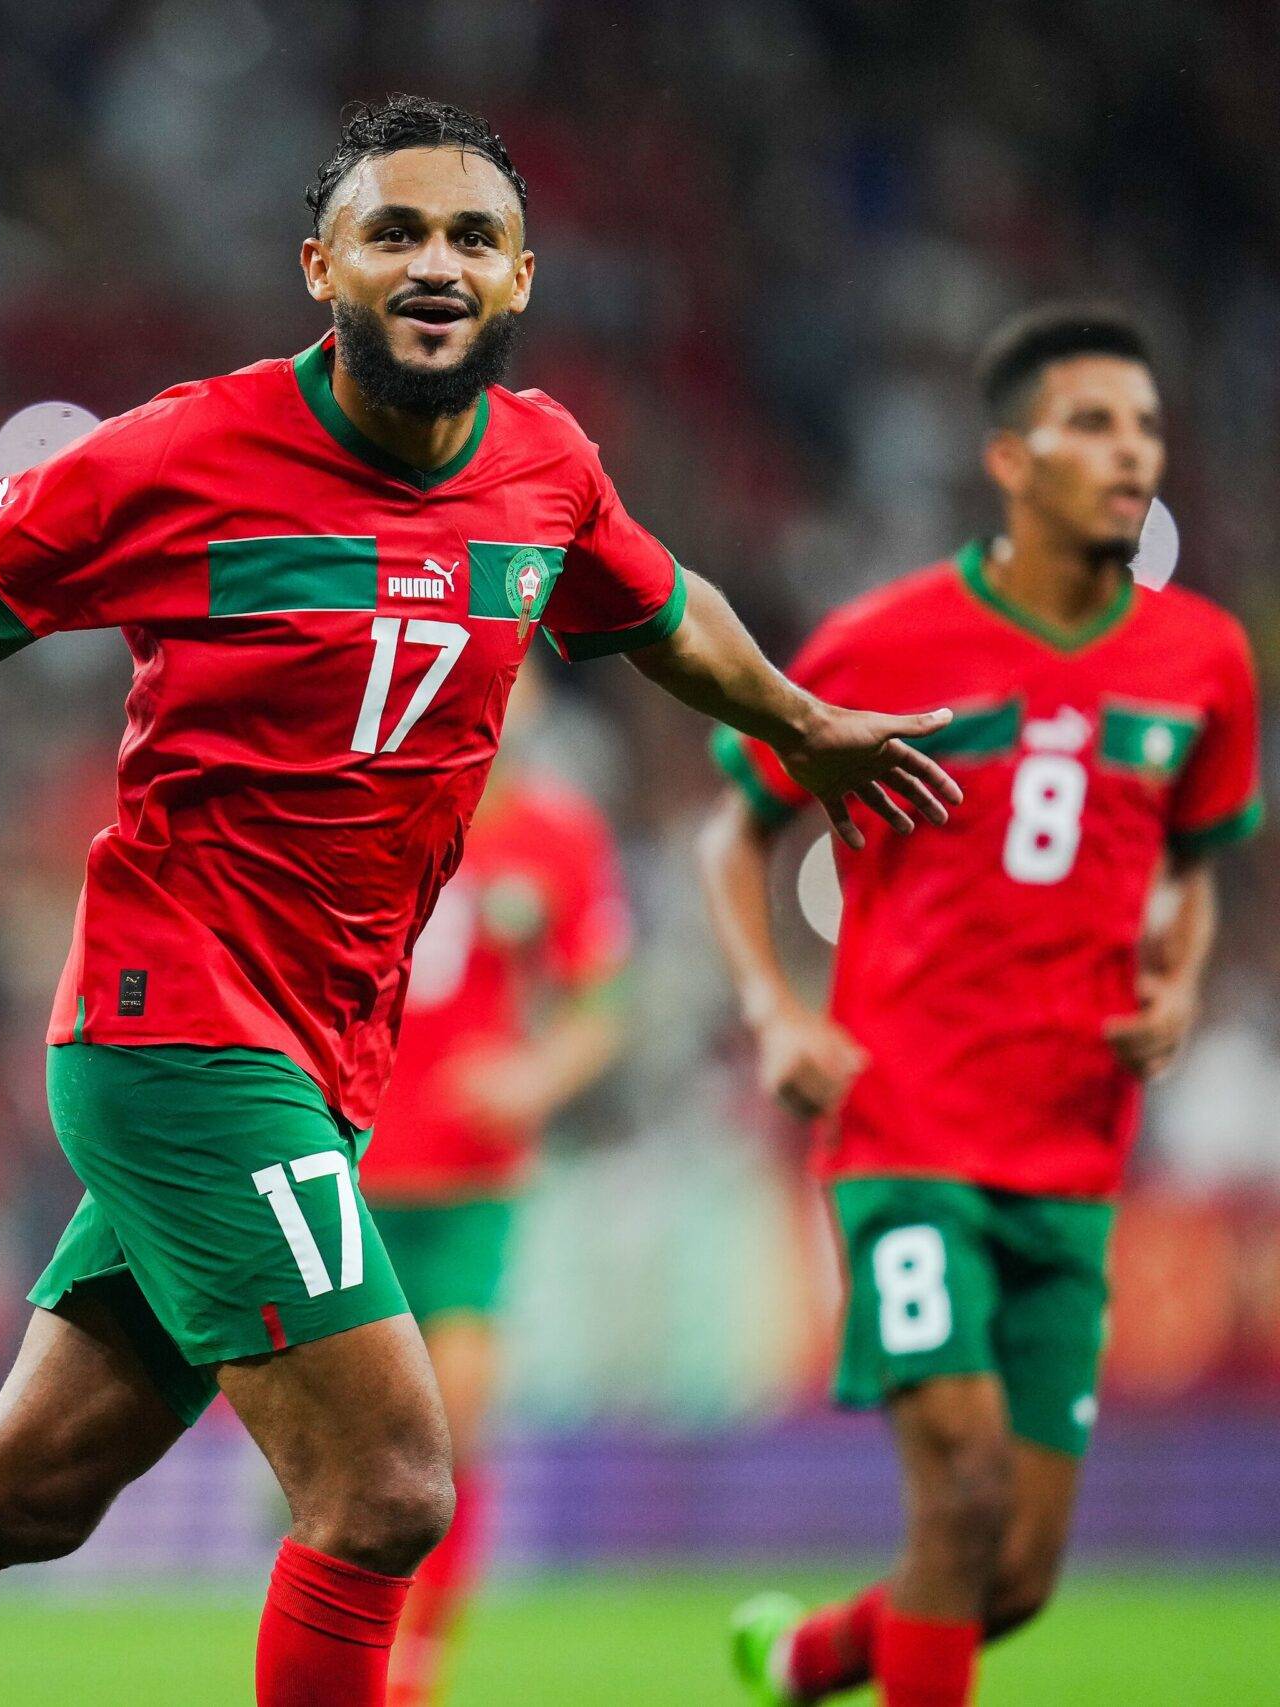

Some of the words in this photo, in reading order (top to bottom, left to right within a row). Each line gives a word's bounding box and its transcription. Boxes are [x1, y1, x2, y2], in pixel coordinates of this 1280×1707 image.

[388, 577, 445, 599] PUMA
[350, 617, 471, 754] 17
[1003, 754, 1088, 885] 8
[251, 1150, 364, 1298] 17
[873, 1224, 952, 1355] 8
